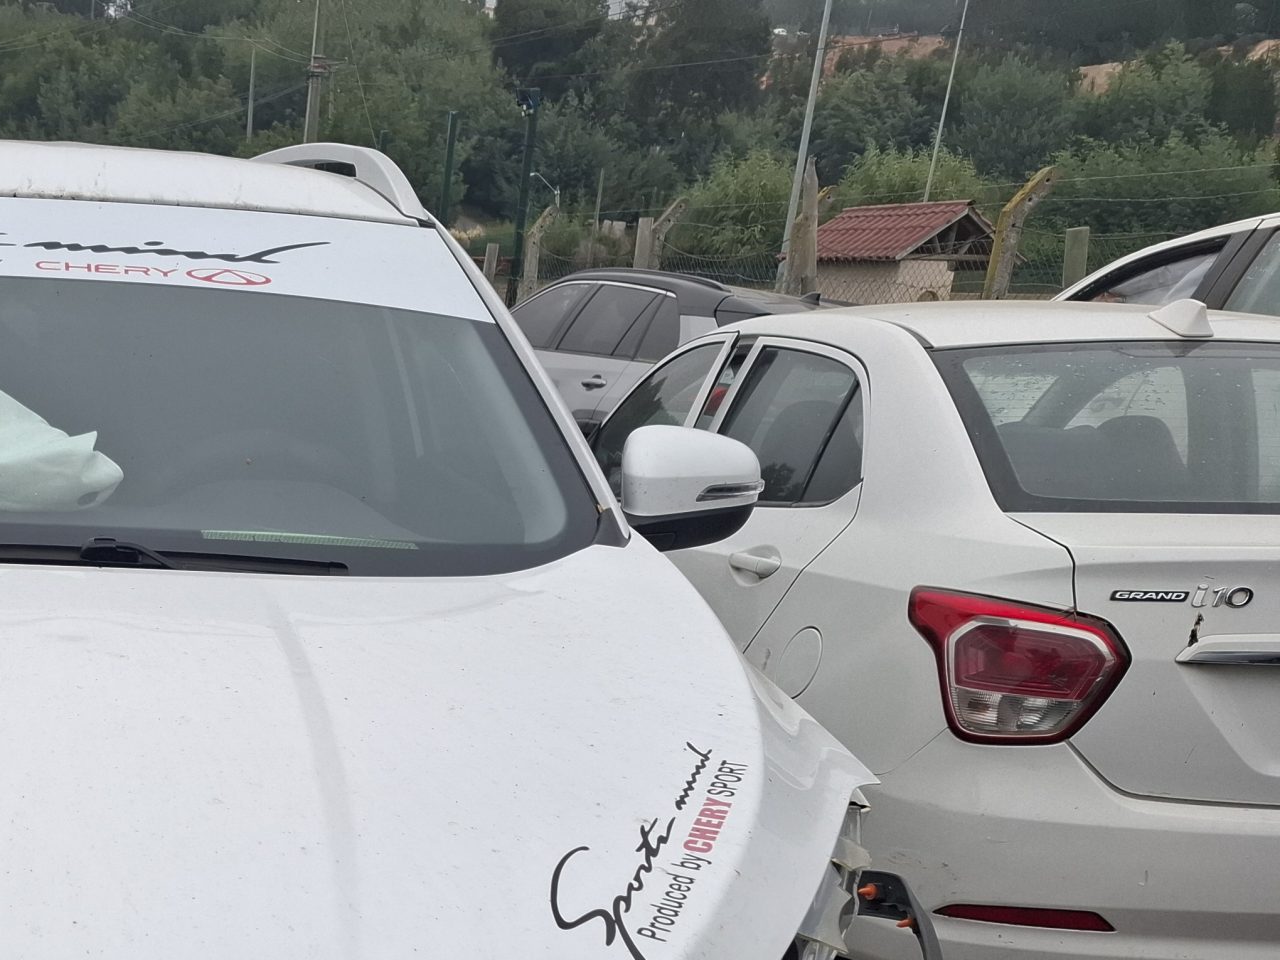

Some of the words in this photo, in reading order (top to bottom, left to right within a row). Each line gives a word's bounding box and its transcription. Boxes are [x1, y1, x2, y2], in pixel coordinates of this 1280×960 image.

[36, 260, 178, 277] CHERY
[1115, 591, 1186, 601] GRAND
[1191, 583, 1254, 608] i10
[706, 760, 748, 797] SPORT
[683, 797, 733, 854] CHERY
[671, 853, 713, 871] by
[636, 870, 697, 943] Produced
